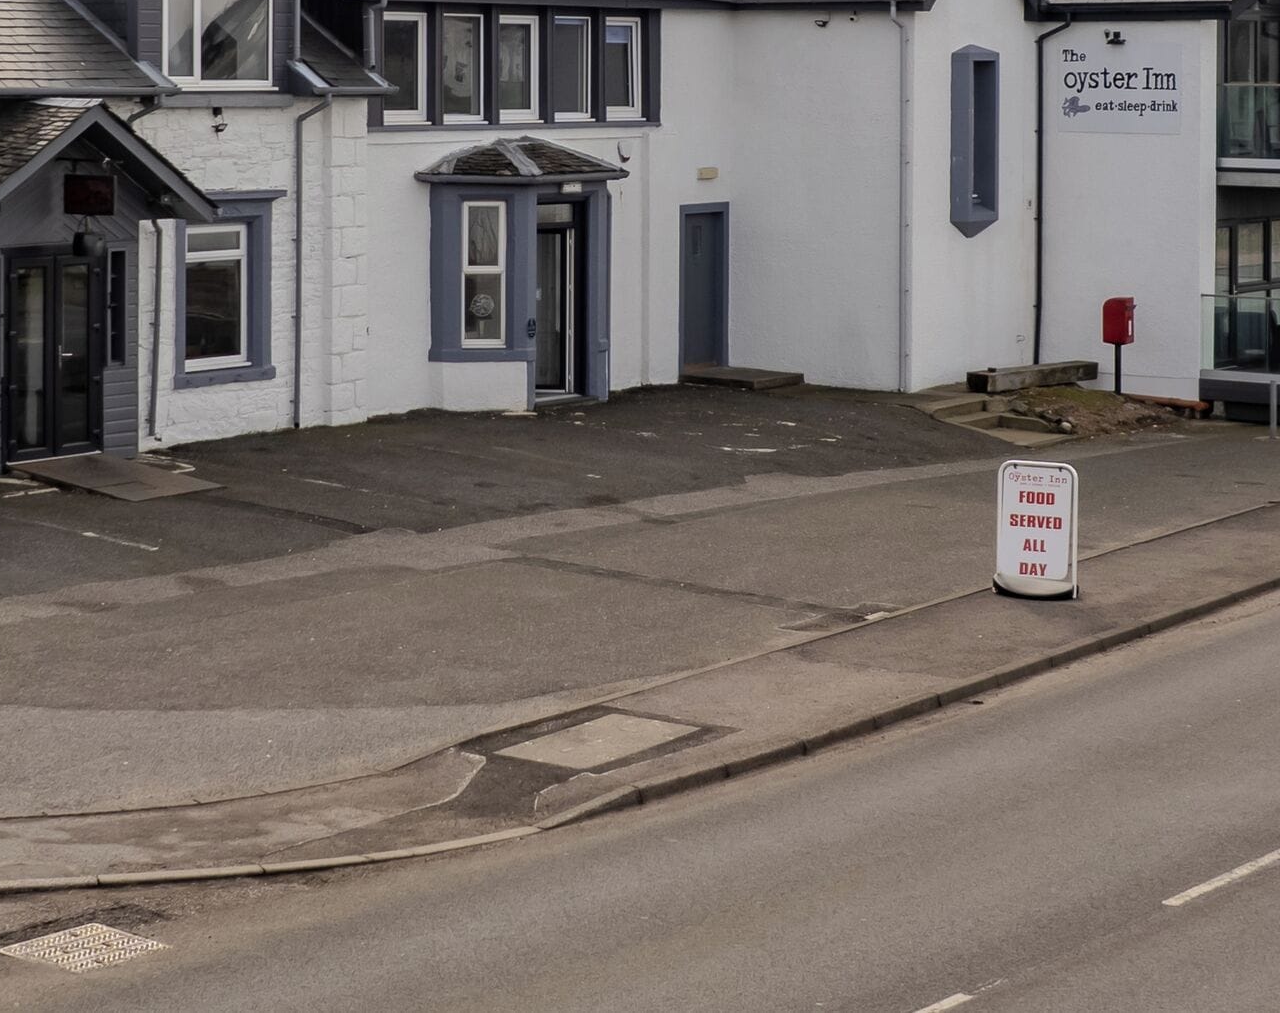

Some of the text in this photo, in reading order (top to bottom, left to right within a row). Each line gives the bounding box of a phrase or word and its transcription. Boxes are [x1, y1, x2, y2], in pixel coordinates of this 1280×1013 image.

[1062, 49, 1087, 63] The
[1063, 67, 1177, 94] oyster Inn
[1008, 472, 1068, 484] Oyster Inn
[1019, 491, 1055, 505] FOOD
[1010, 514, 1062, 529] SERVED
[1023, 539, 1047, 552] ALL
[1019, 562, 1047, 576] DAY
